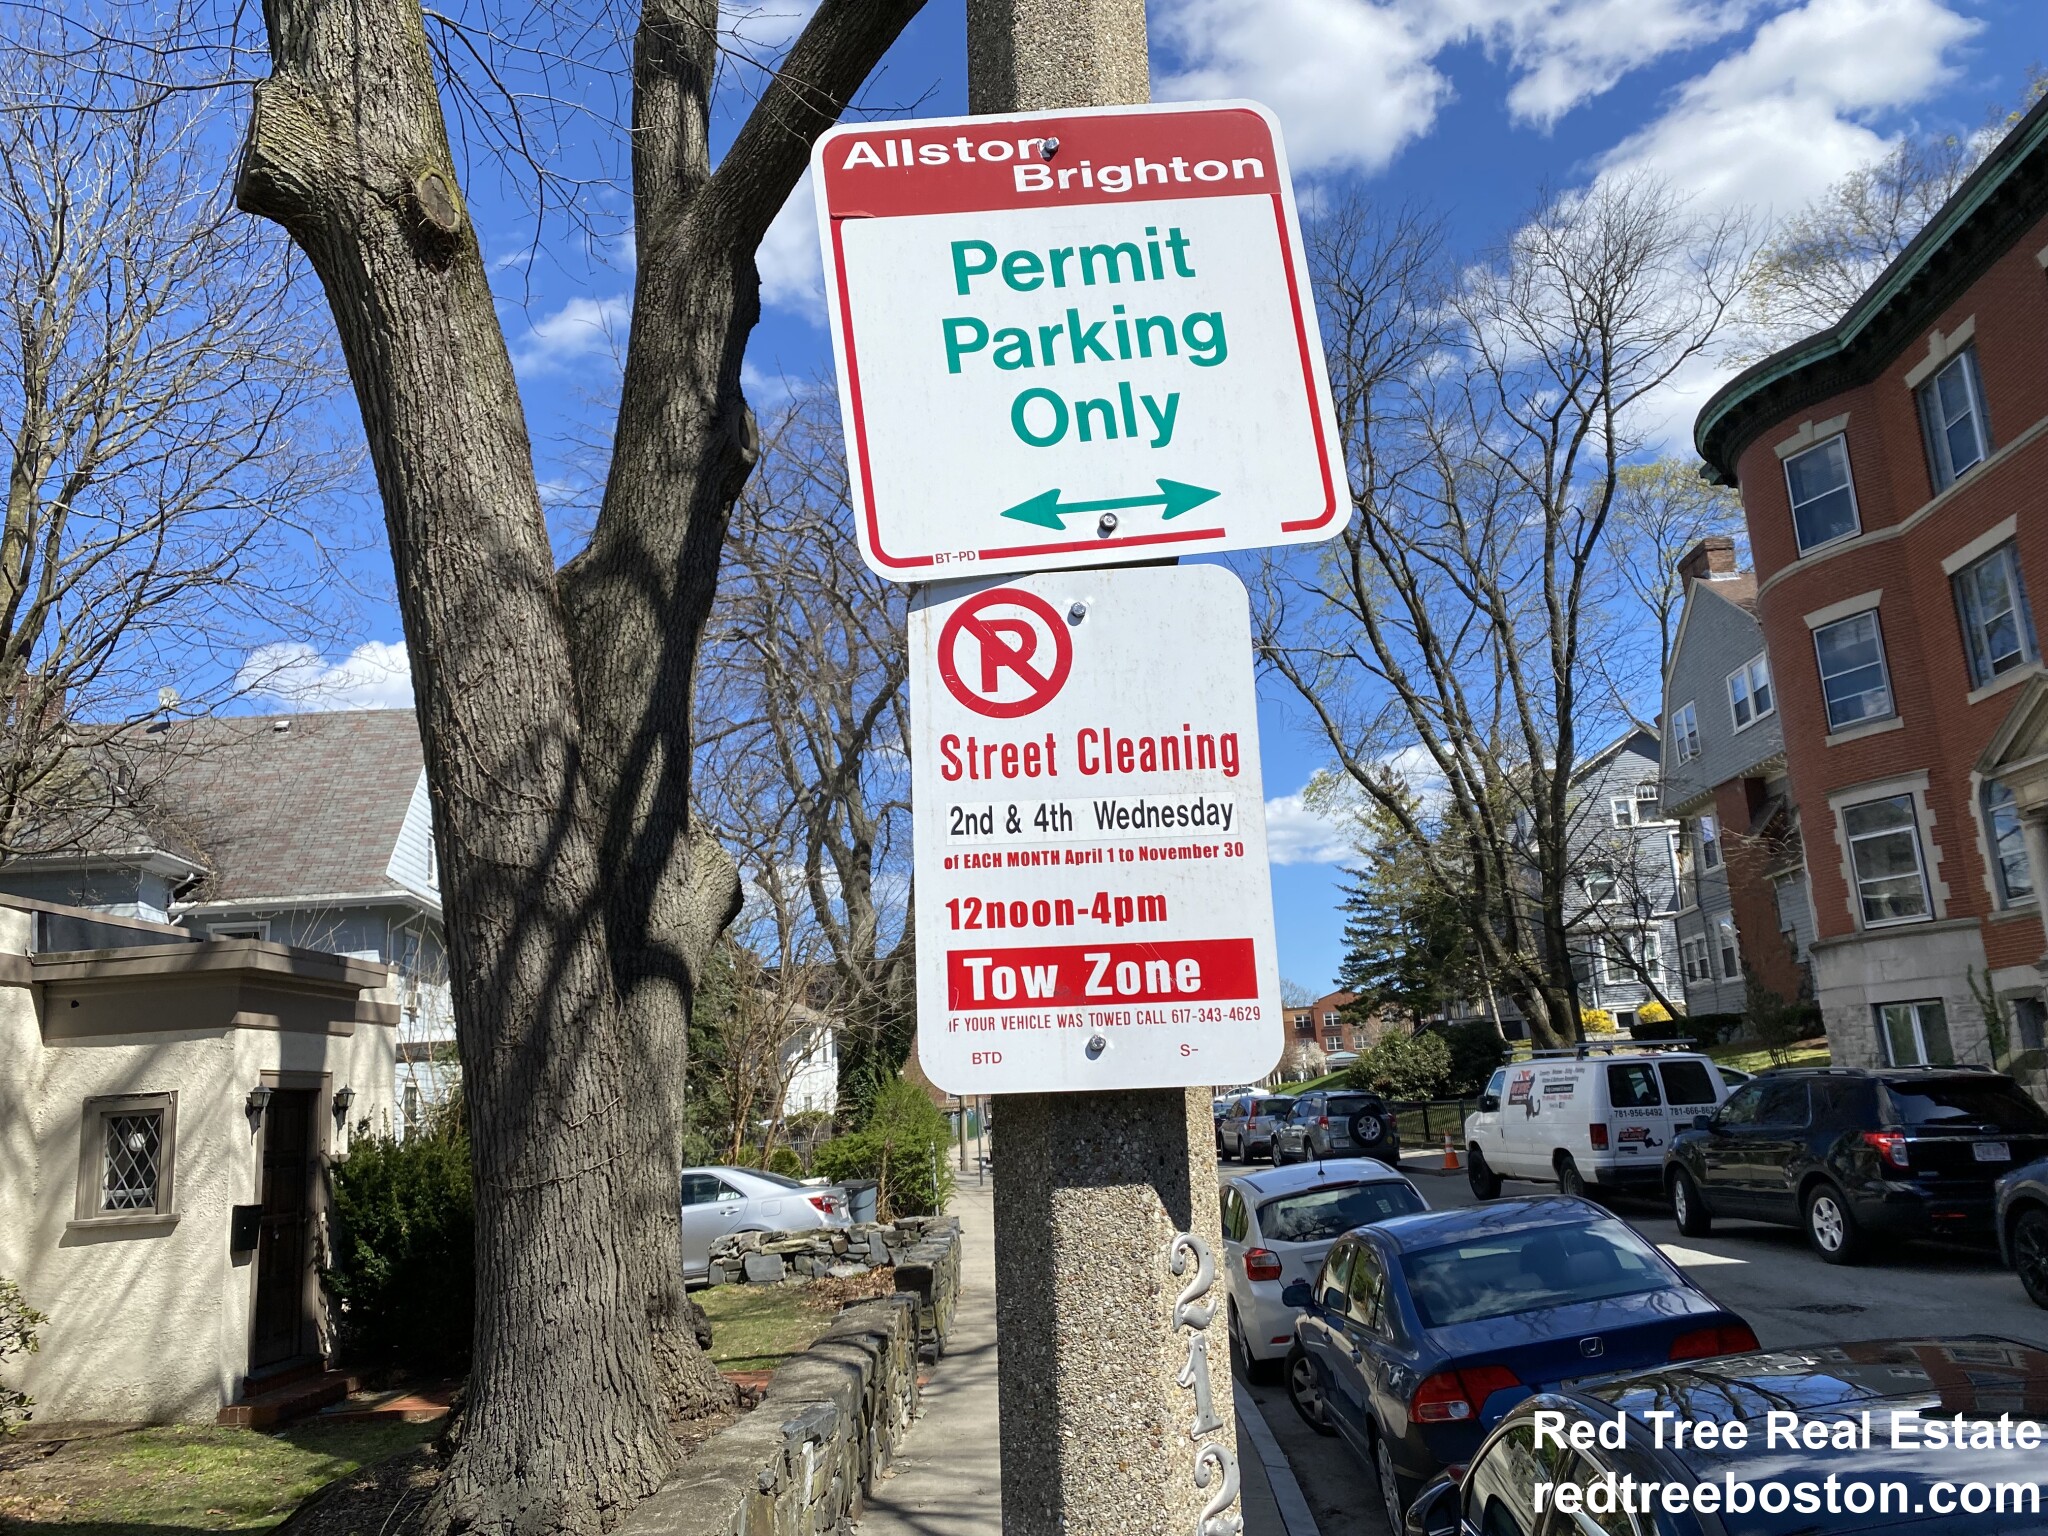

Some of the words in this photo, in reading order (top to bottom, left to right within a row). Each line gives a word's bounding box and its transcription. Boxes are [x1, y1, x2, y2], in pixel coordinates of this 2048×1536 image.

[1013, 155, 1265, 194] Brighton
[951, 227, 1195, 295] Permit
[943, 305, 1227, 373] Parking
[1011, 382, 1179, 448] Only
[935, 551, 976, 564] BT-PD
[940, 733, 1057, 781] Street
[1078, 724, 1239, 777] Cleaning
[951, 806, 993, 835] 2nd
[1006, 805, 1021, 833] &
[1035, 803, 1072, 832] 4th
[1094, 797, 1232, 831] Wednesday
[944, 855, 959, 870] of
[964, 853, 1002, 869] EACH
[1007, 850, 1060, 867] MONTH
[1065, 848, 1102, 865] April
[1108, 848, 1114, 862] 1
[1119, 849, 1134, 862] to
[1139, 844, 1219, 861] November
[1224, 842, 1244, 857] 30
[946, 892, 1167, 930] 12noon-4pm
[964, 958, 1057, 1000] Tow
[1085, 953, 1200, 995] Zone
[949, 1019, 959, 1033] IF
[964, 1017, 995, 1031] YOUR
[1001, 1015, 1051, 1030] VEHICLE
[1057, 1013, 1083, 1028] WAS
[1090, 1011, 1131, 1026] TOWED
[1136, 1010, 1166, 1025] CALL
[1171, 1006, 1261, 1023] 617-343-4629
[972, 1052, 1002, 1064] BTD
[1171, 1232, 1243, 1536] 212
